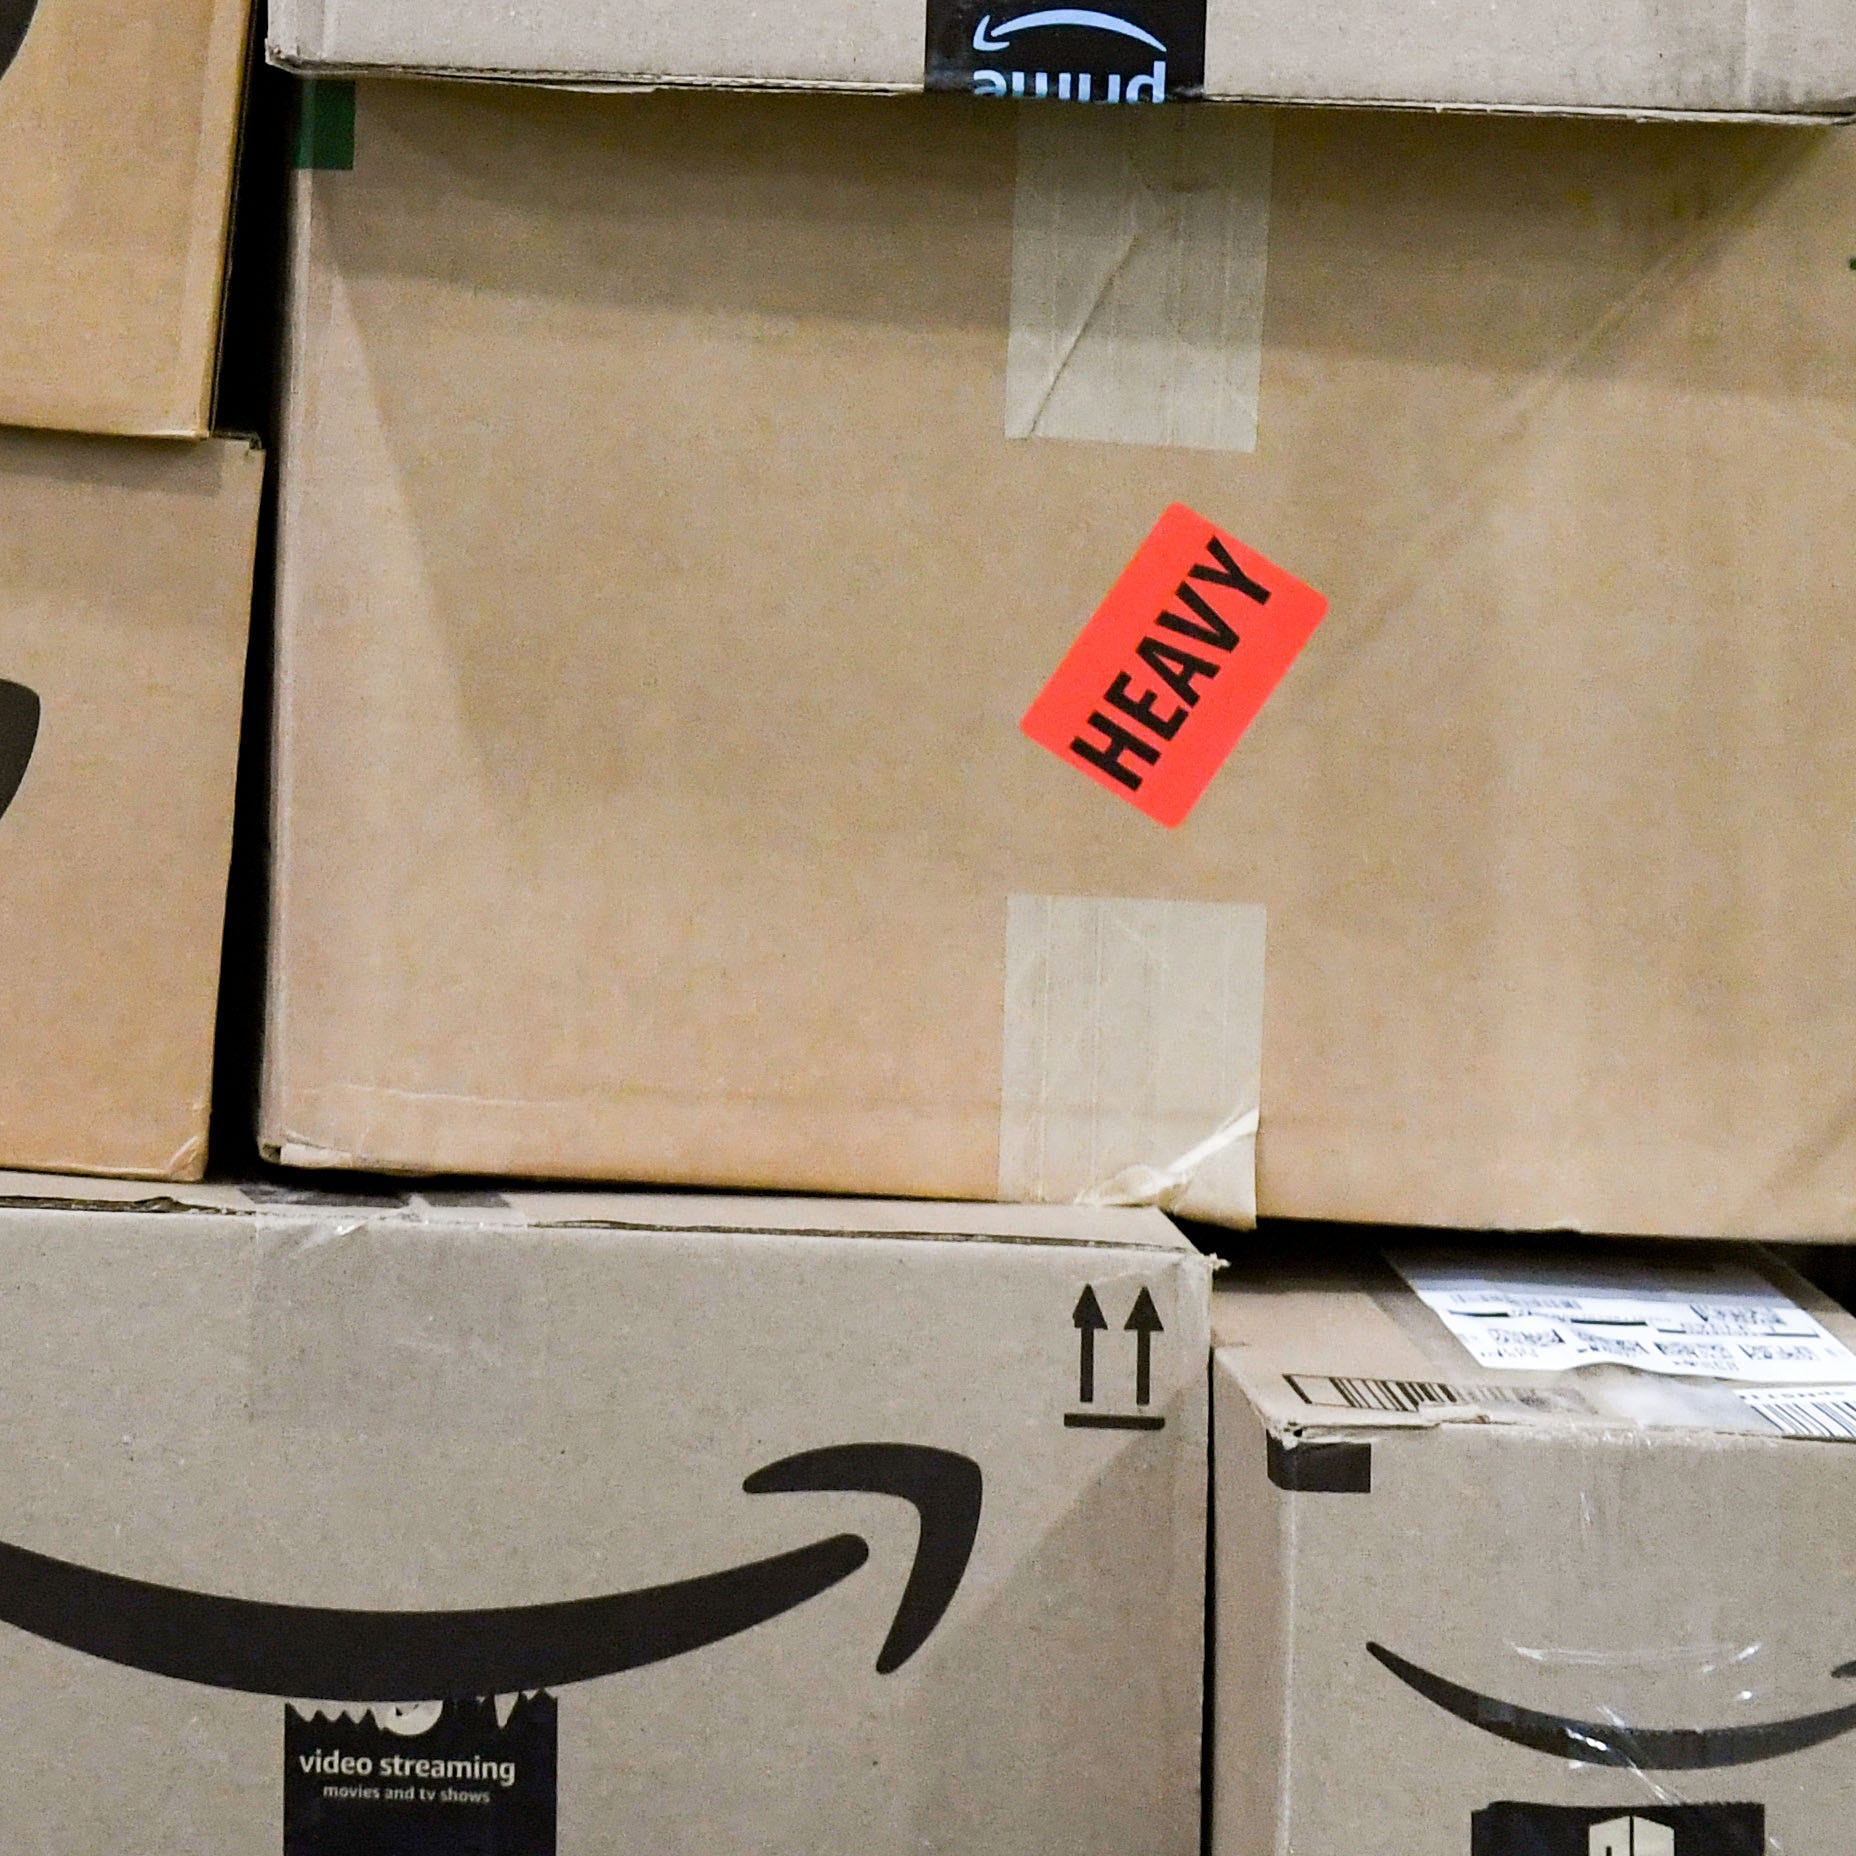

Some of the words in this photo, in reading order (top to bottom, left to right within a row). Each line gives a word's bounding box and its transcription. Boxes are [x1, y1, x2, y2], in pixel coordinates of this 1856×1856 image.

[1068, 535, 1272, 792] HEAVY
[299, 1749, 373, 1776] video
[379, 1755, 516, 1787] streaming
